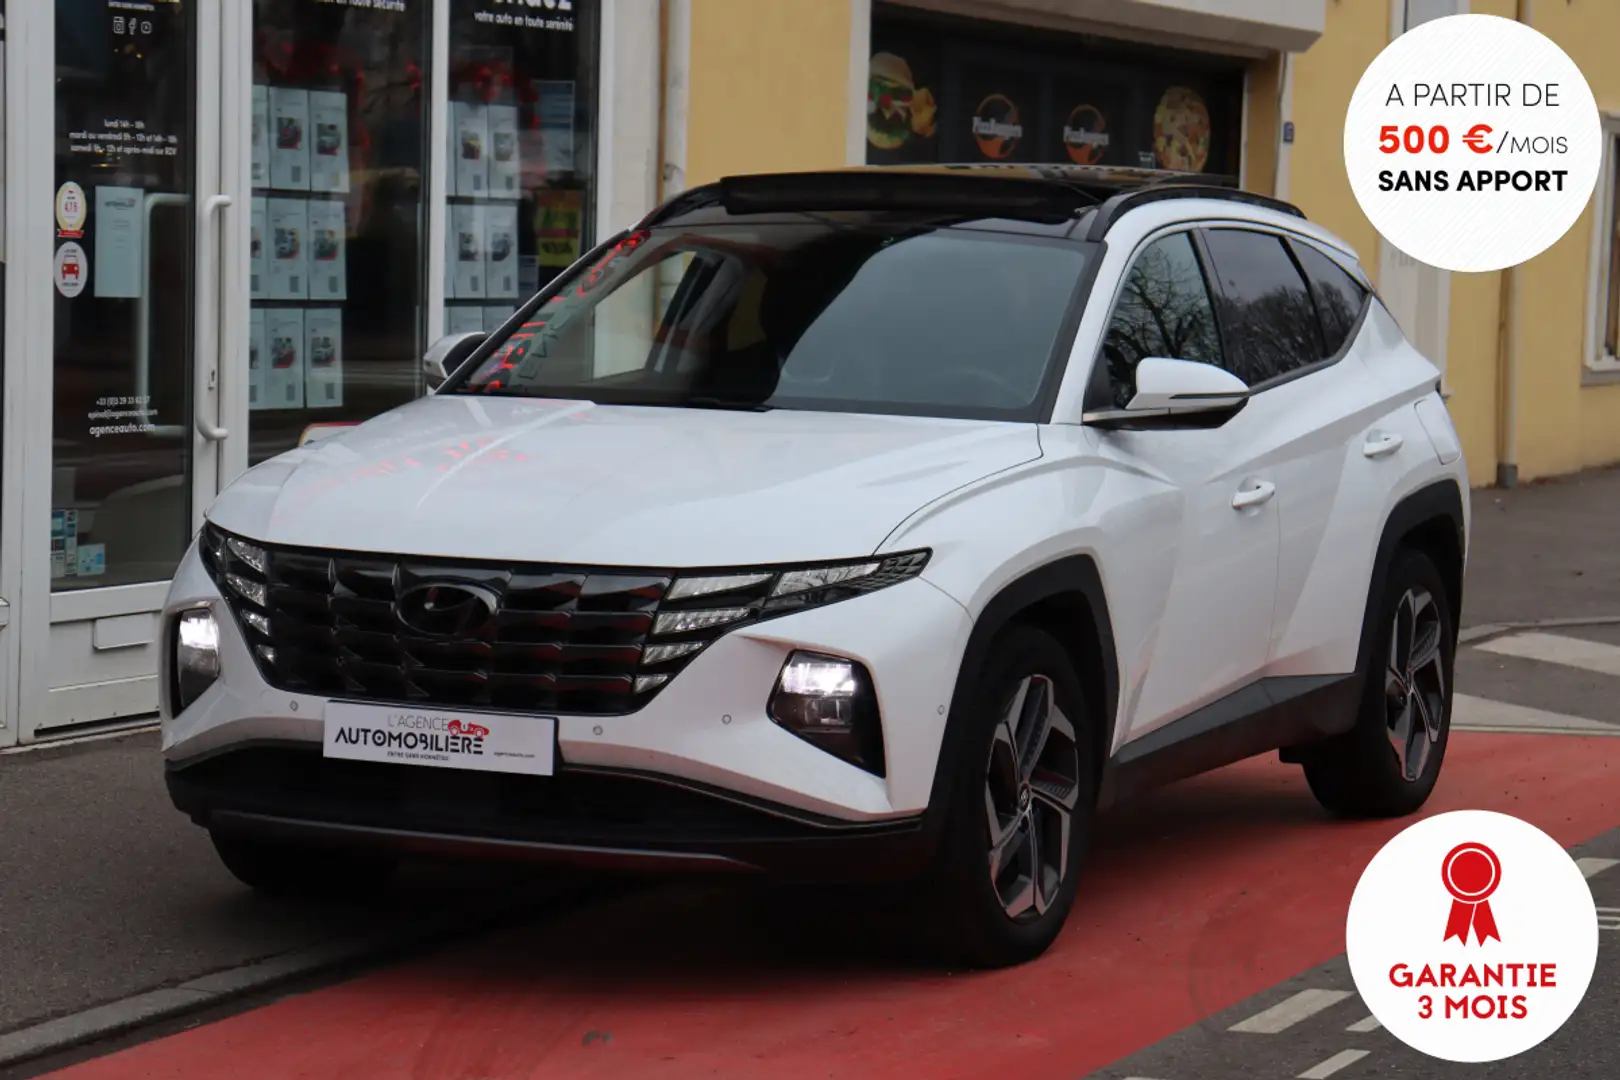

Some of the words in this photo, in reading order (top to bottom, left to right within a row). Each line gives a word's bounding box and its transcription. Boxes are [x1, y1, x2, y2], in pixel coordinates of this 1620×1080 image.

[474, 11, 494, 22] votre
[495, 13, 513, 24] auto
[514, 16, 523, 26] en
[525, 14, 544, 28] toute
[89, 422, 156, 438] agenceauto.com
[387, 714, 449, 732] L'AGENCE
